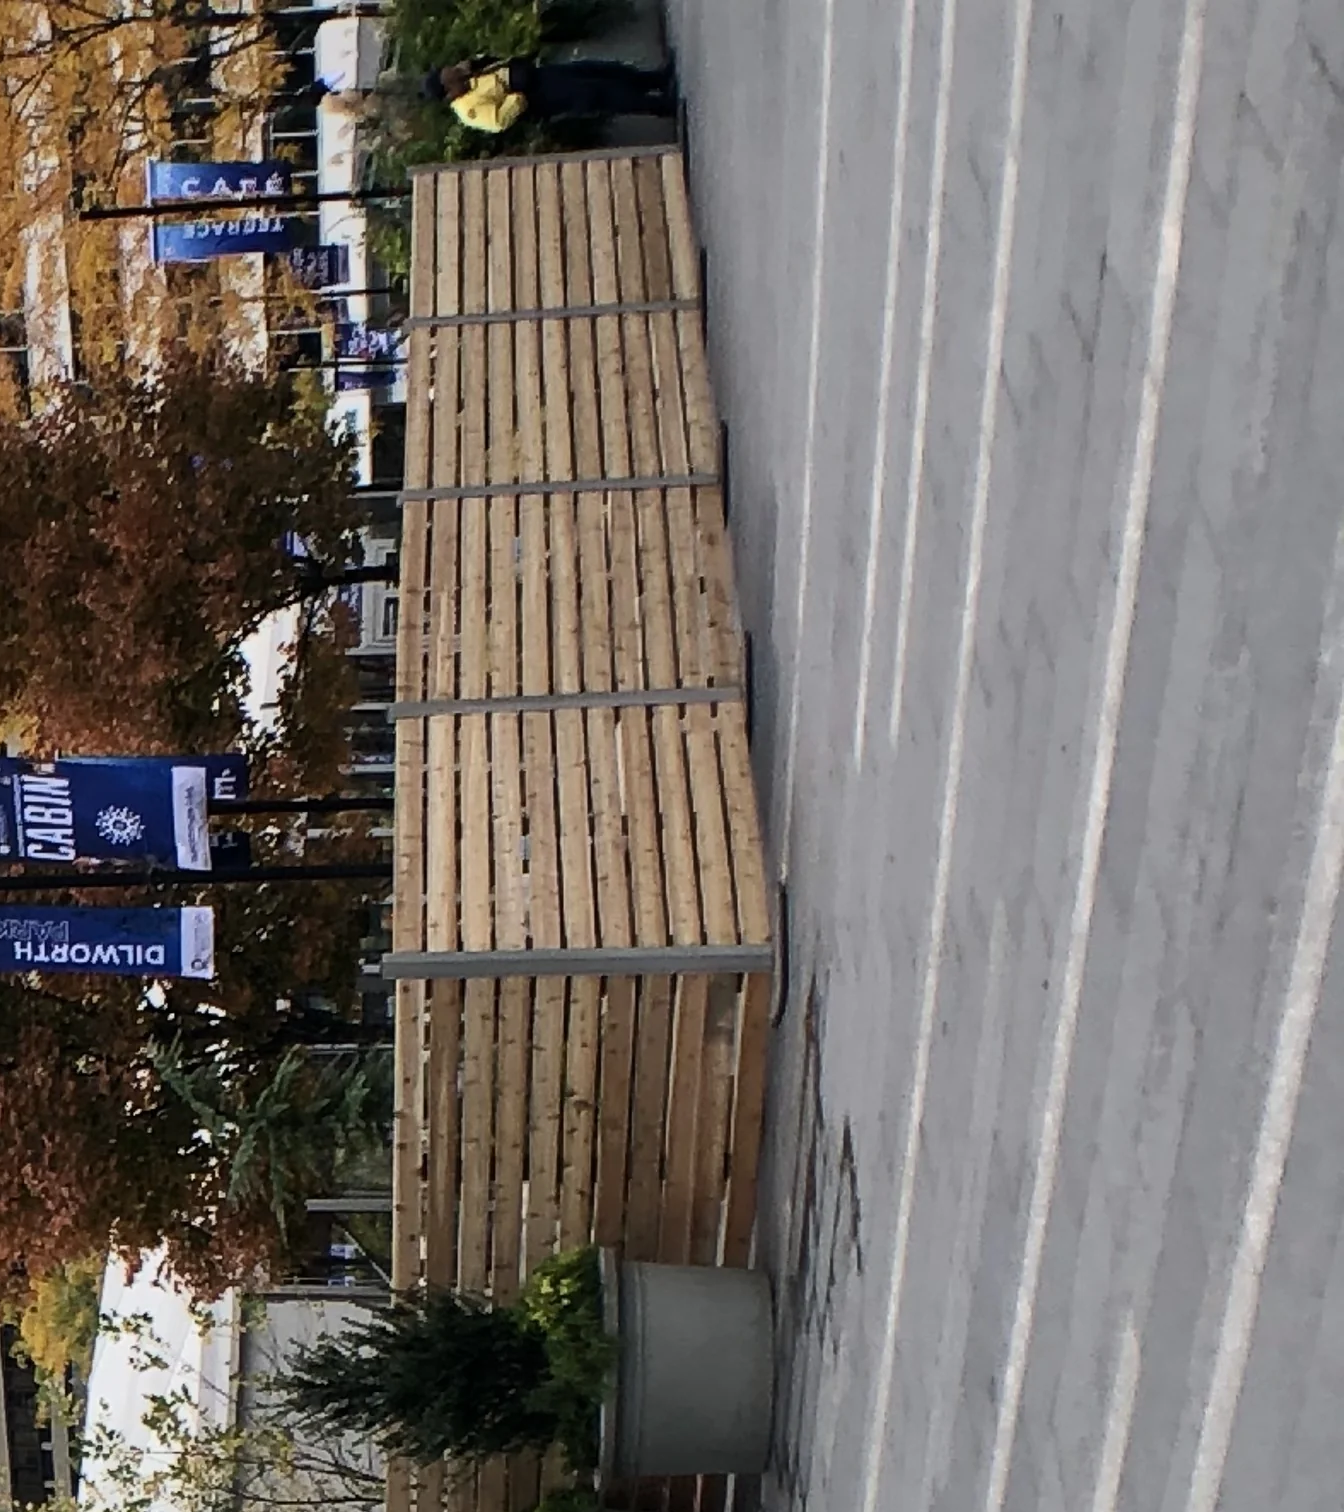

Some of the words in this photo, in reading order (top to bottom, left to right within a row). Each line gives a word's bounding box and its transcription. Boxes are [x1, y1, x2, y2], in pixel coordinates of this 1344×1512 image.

[182, 217, 284, 239] TERRACE
[21, 773, 76, 861] CABIN
[14, 943, 165, 966] DILWORTH
